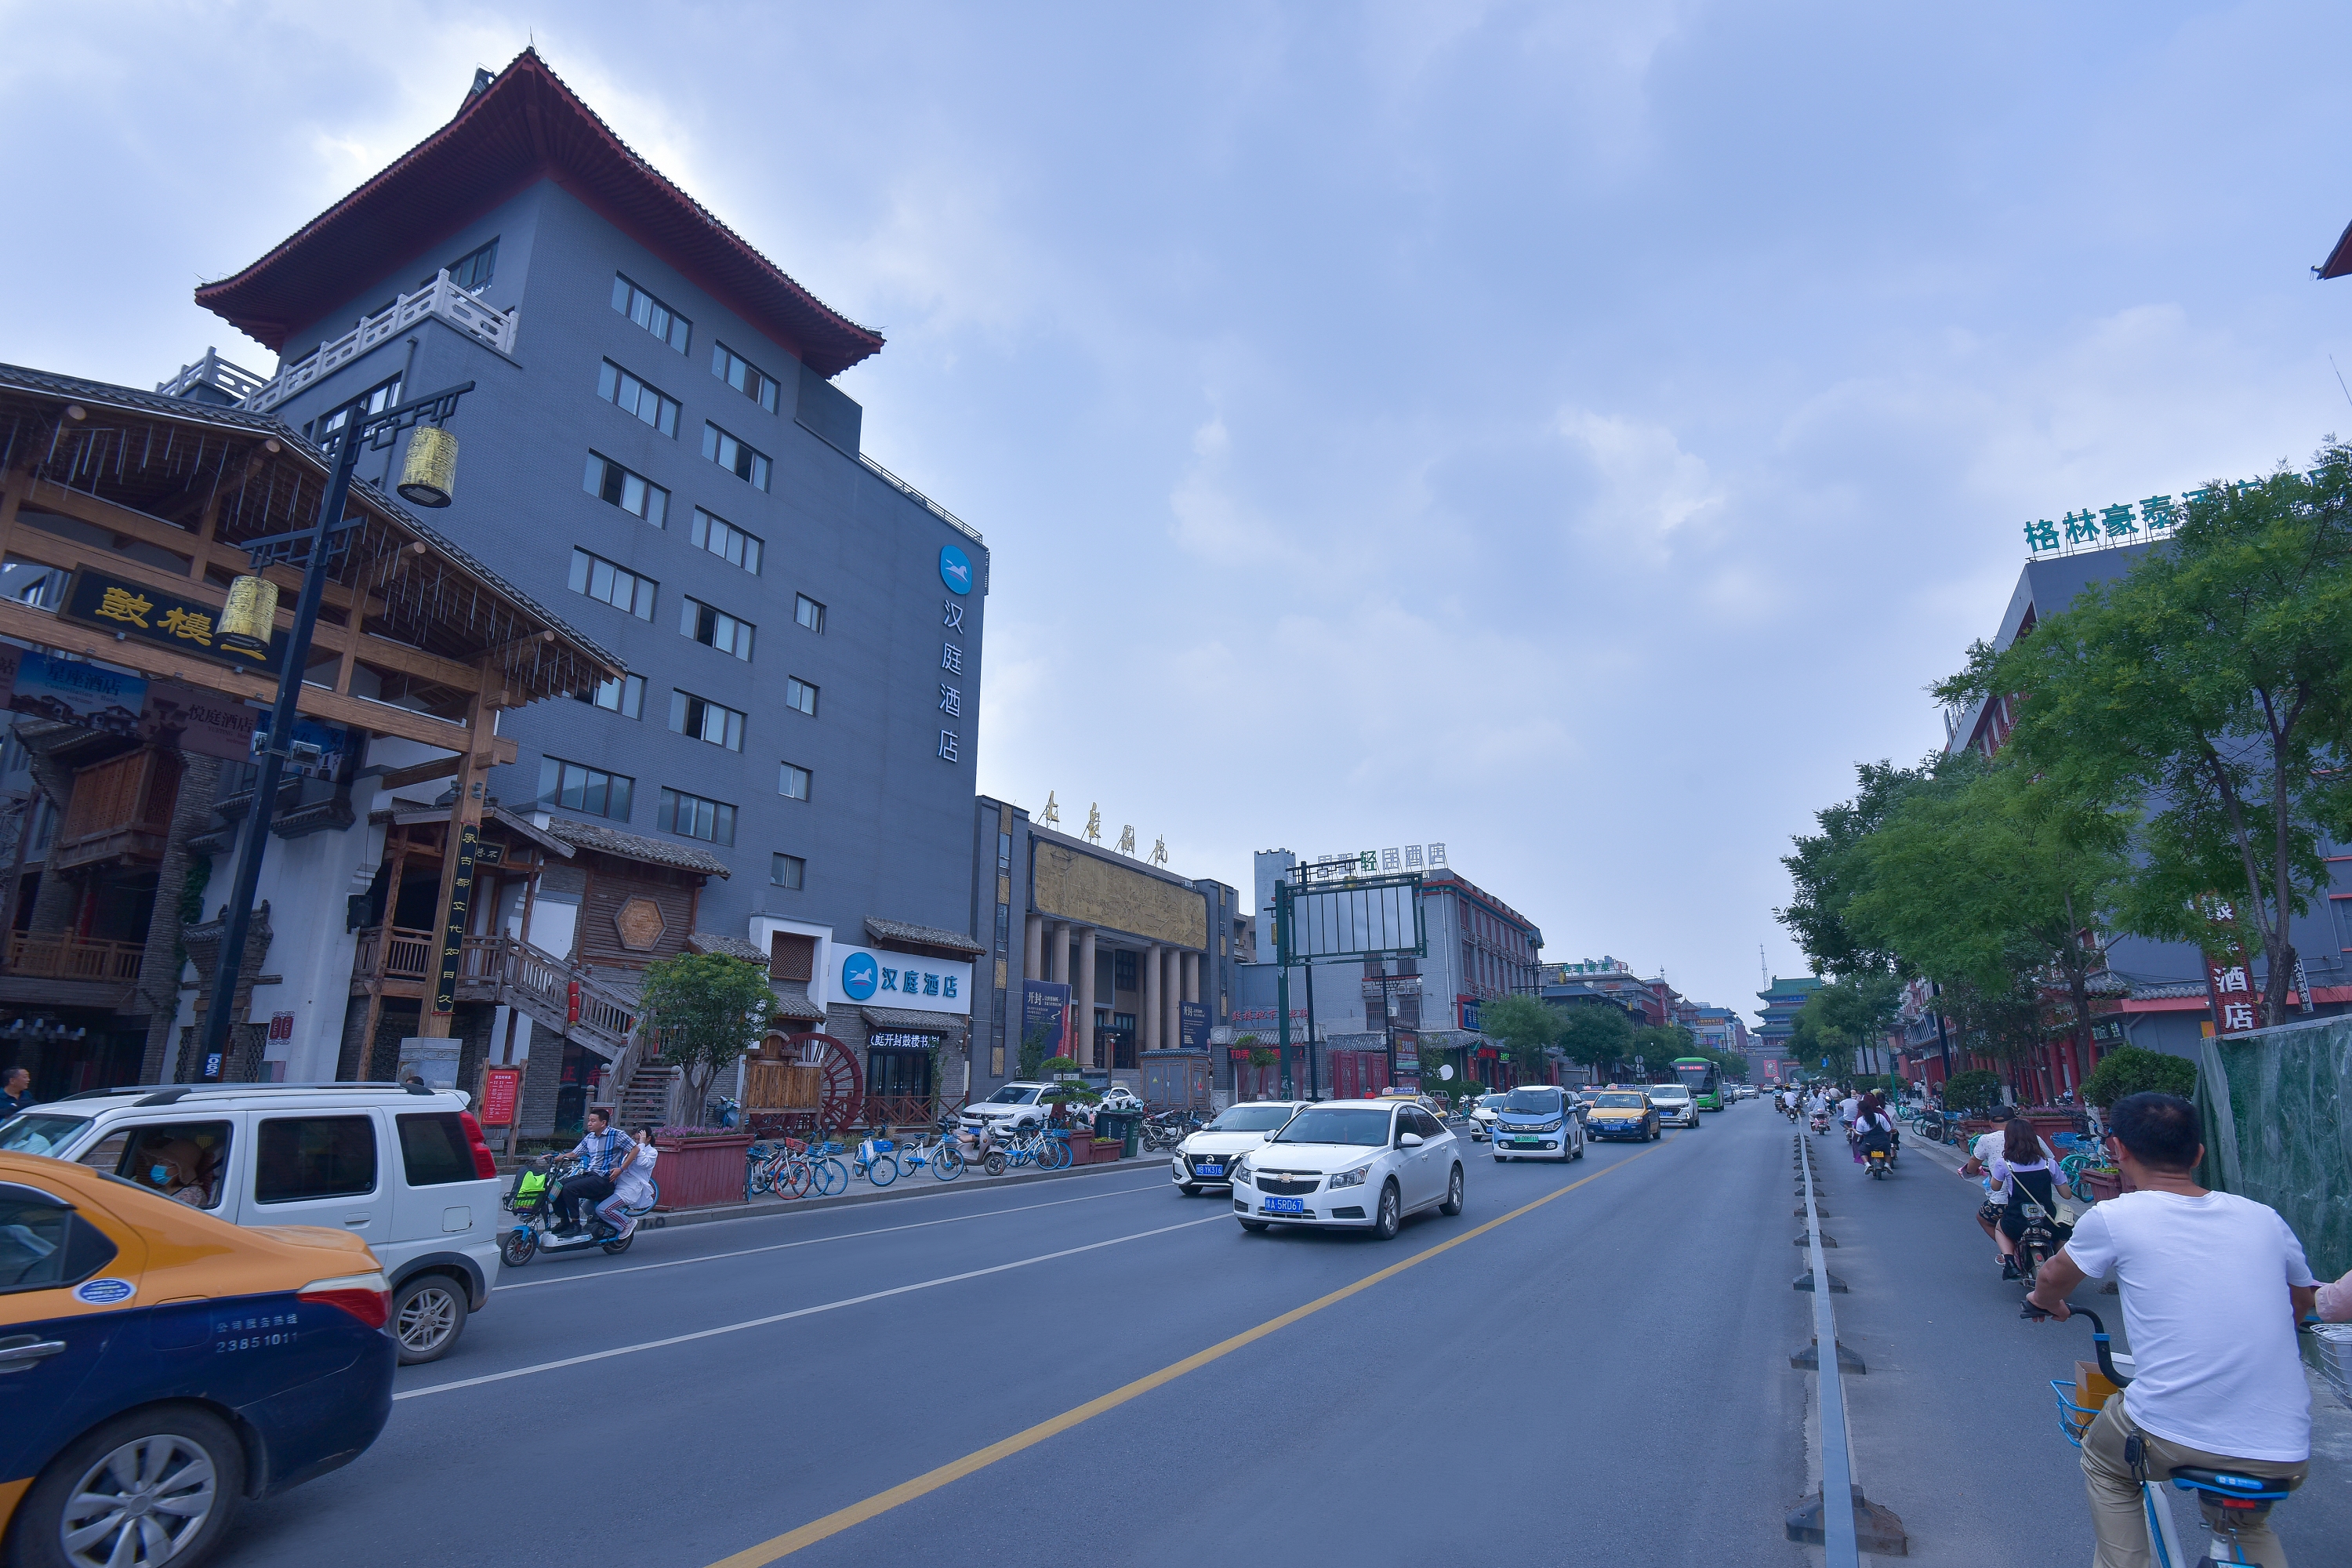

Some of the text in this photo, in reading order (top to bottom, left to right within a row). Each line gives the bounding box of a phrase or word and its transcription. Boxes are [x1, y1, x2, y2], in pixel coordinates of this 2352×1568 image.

[46, 663, 122, 696] 星座酒店
[938, 599, 964, 763] 汉庭酒店
[67, 695, 93, 706] welcome
[189, 704, 254, 734] 悦庭酒店
[208, 725, 233, 738] YUETING
[226, 738, 249, 746] welcome
[881, 967, 958, 998] 汉庭酒店
[1027, 992, 1042, 1006] 开封
[1232, 1008, 1308, 1021] 鼓楼地下业街
[216, 1313, 298, 1333] 公司服务热线
[216, 1332, 298, 1353] 23851011
